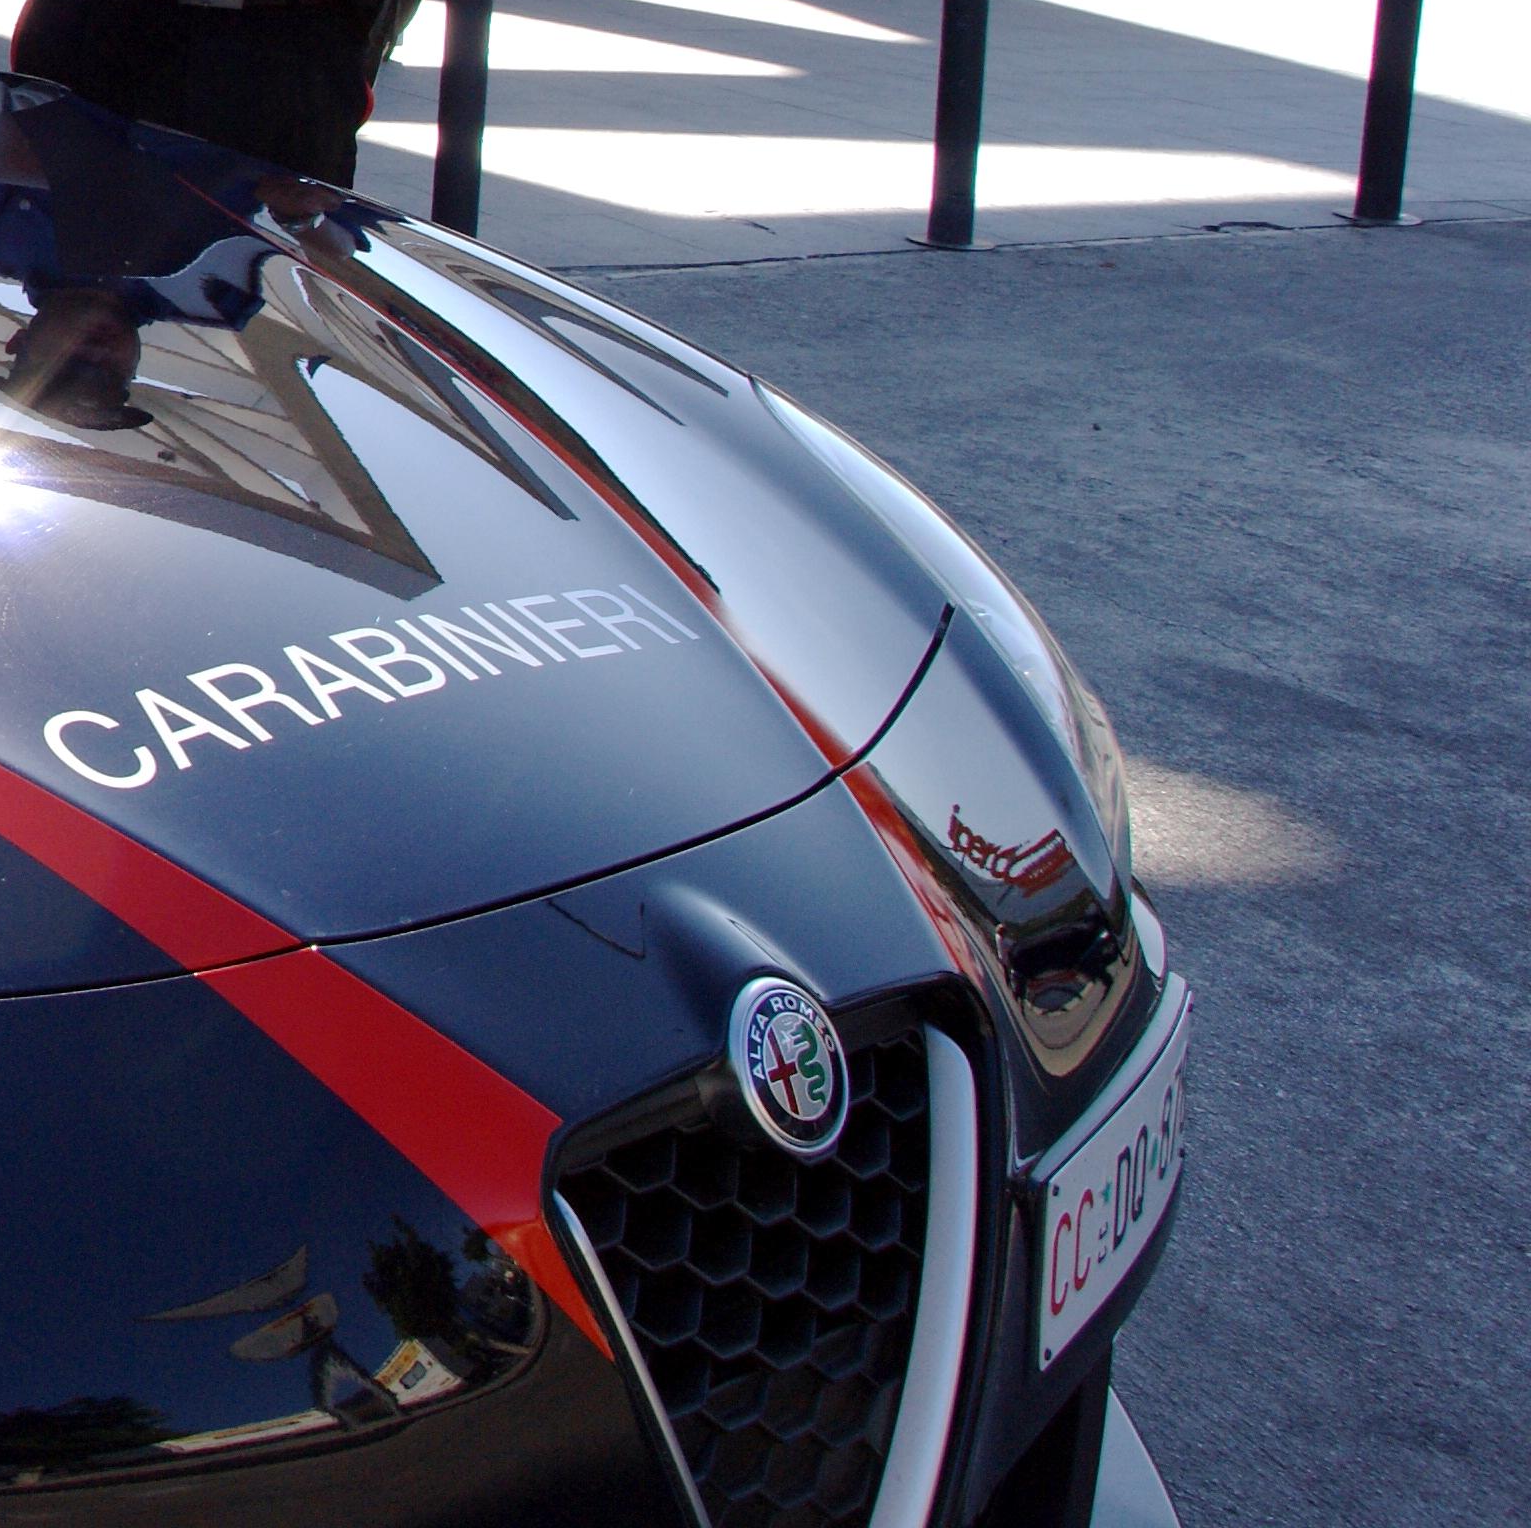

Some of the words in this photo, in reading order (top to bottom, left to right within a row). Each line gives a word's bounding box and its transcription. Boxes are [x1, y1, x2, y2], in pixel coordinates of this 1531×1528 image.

[42, 583, 701, 790] CARABINIERI
[750, 1013, 770, 1081] ALFA
[769, 995, 836, 1053] ROMEO
[1050, 1187, 1094, 1316] CC
